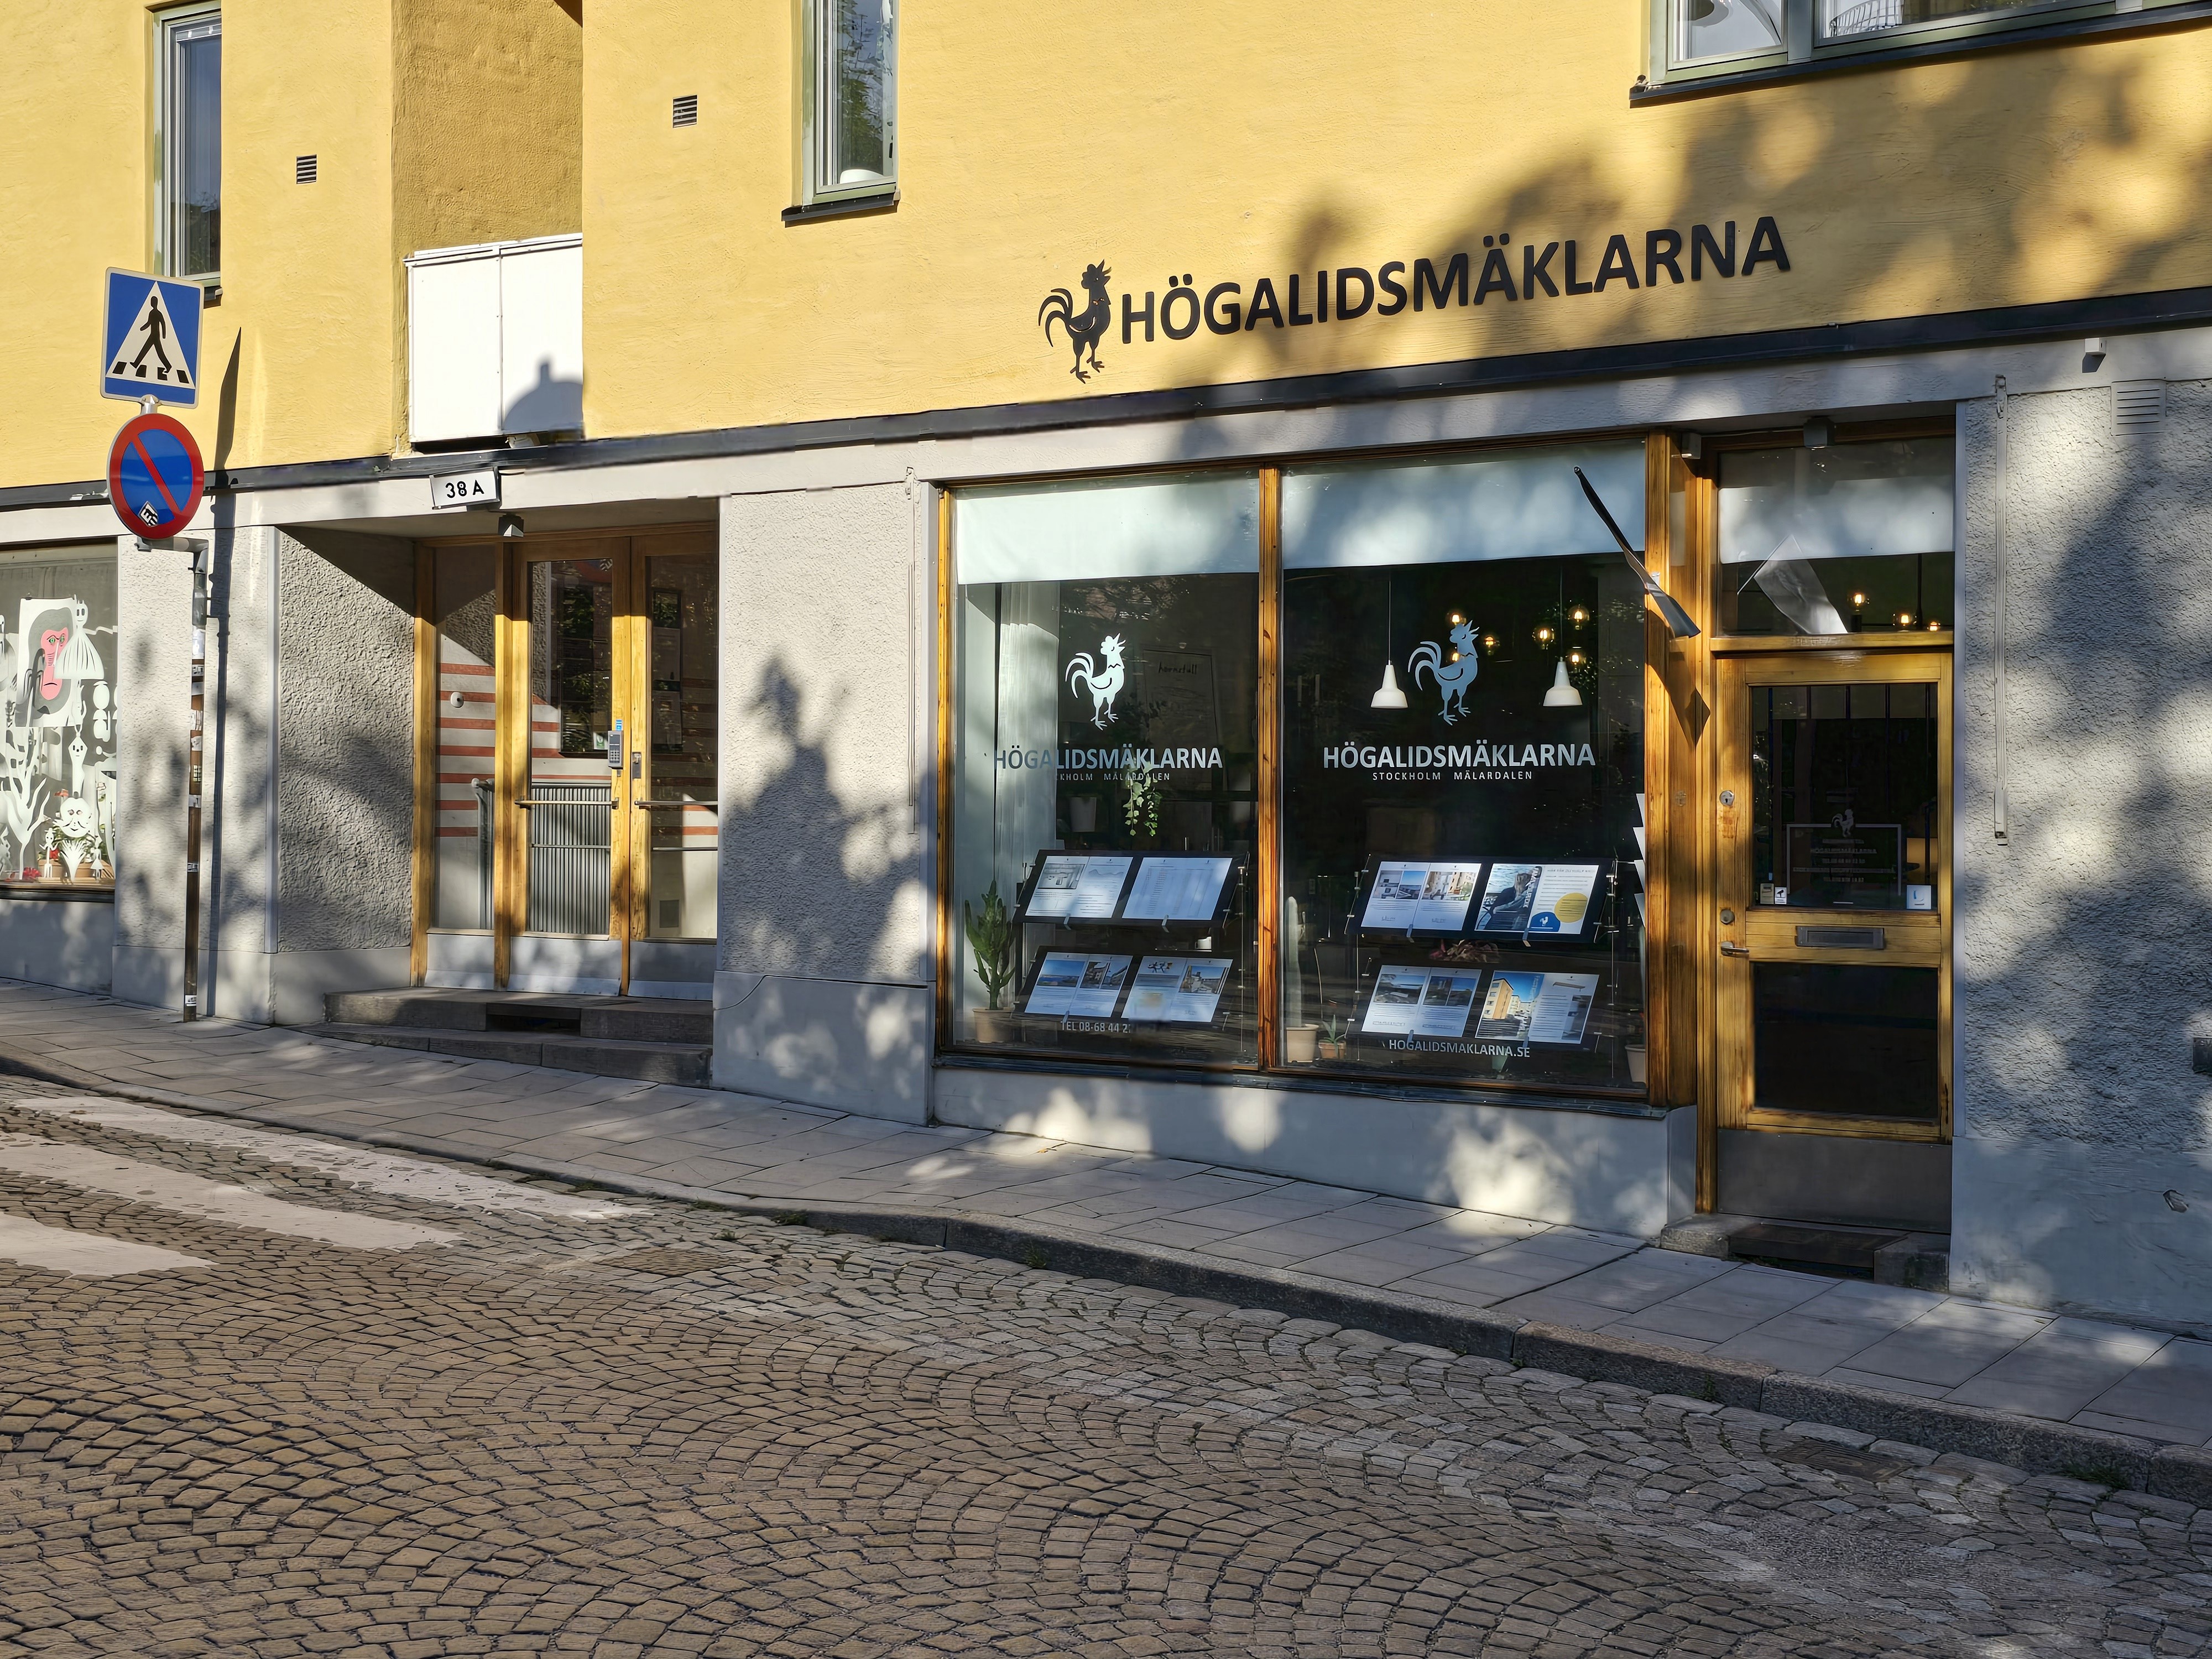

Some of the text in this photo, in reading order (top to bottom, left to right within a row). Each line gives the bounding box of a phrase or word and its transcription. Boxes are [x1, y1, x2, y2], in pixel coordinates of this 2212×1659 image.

[1121, 215, 1791, 344] HÖGALIDSMÄKLARNA
[446, 479, 484, 498] 38 A
[994, 743, 1223, 770] HÖGALIDSMÄKLARNA
[1324, 739, 1596, 768] HÖGALIDSMÄKLARNA
[1373, 770, 1532, 780] STOCKHOLM MÄLARDALEN
[1061, 1021, 1077, 1031] TEL
[1079, 1022, 1105, 1032] 08-68
[1108, 1023, 1119, 1032] 44
[1389, 1039, 1530, 1057] HOGALIDSMAKLARNA.SE
